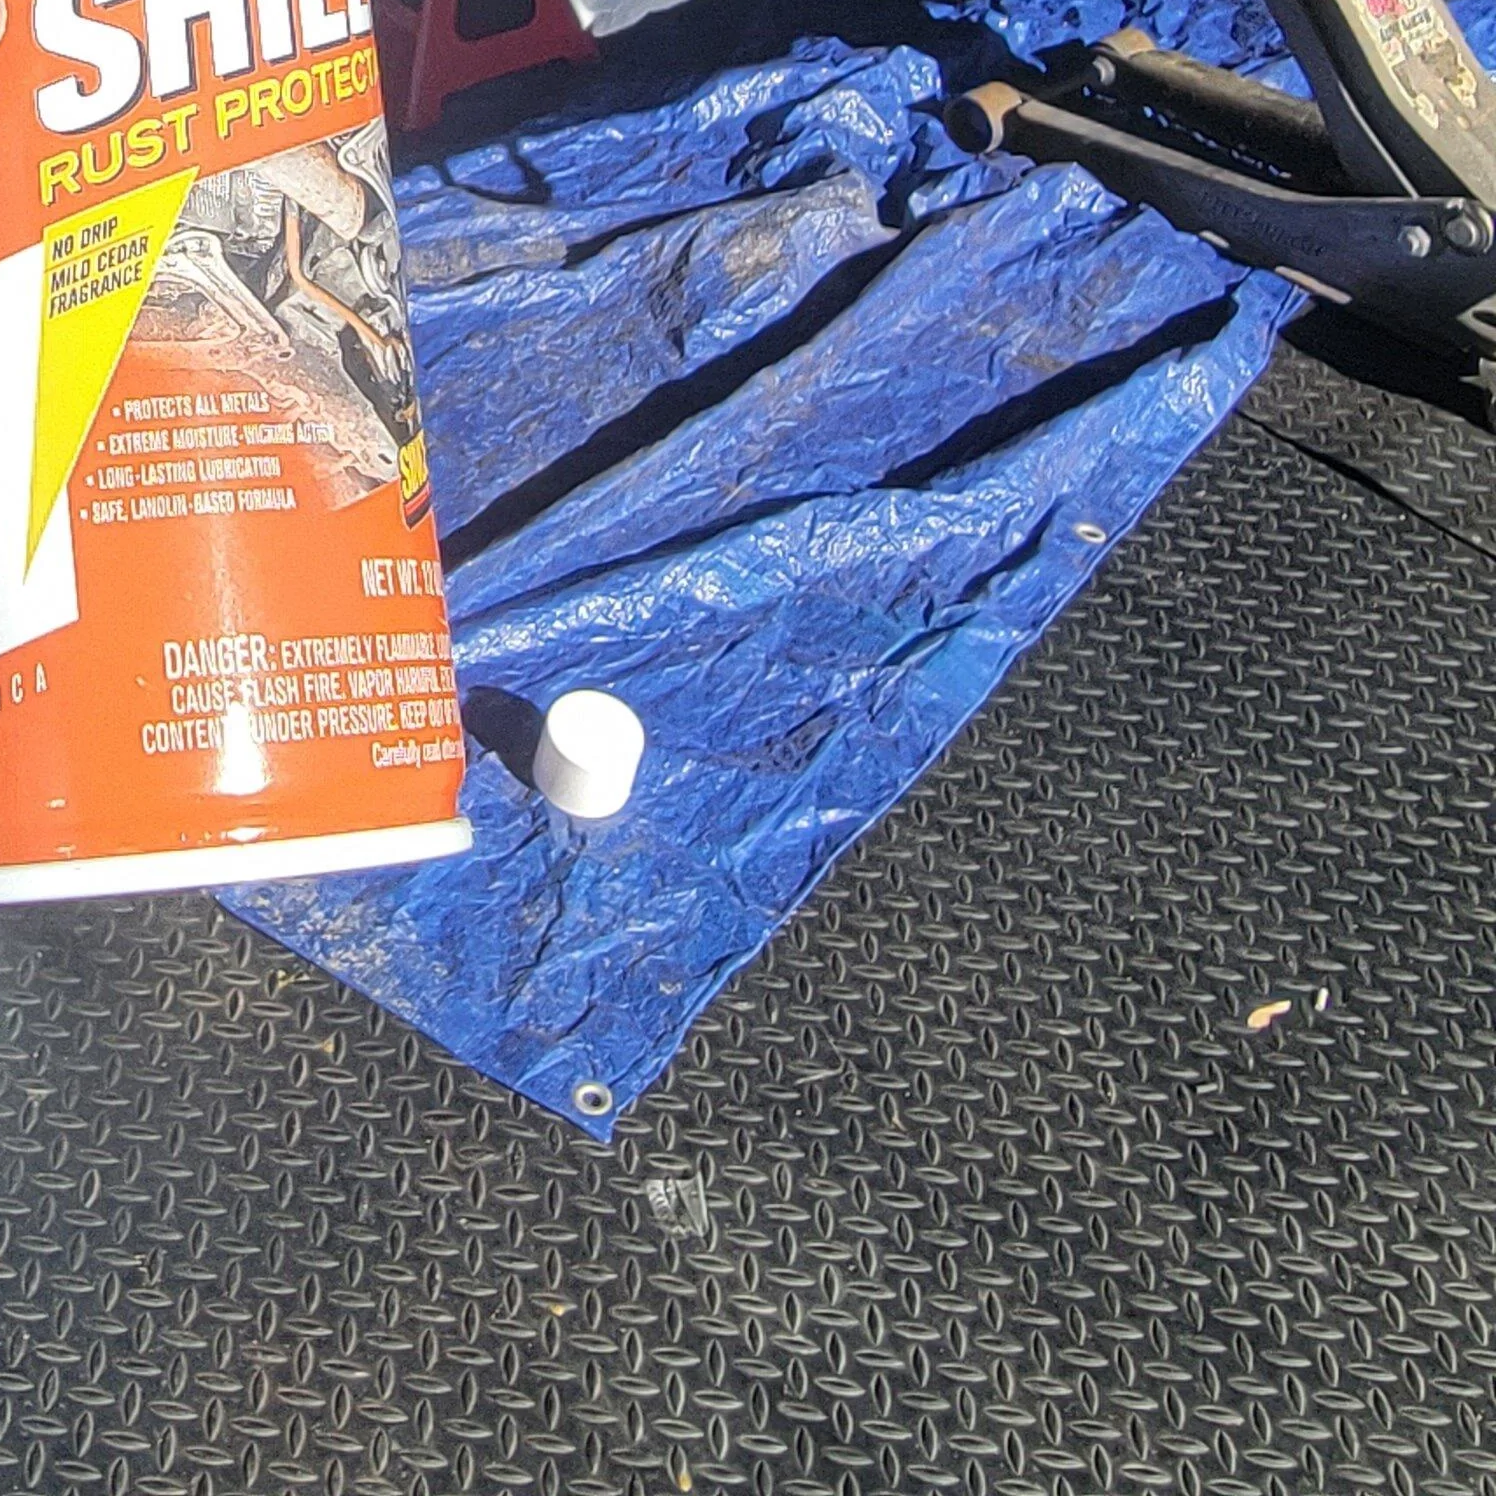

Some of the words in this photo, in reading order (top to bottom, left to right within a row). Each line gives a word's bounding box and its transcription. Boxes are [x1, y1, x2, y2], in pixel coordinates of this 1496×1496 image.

[39, 104, 198, 206] RUST
[52, 238, 74, 261] NO
[80, 216, 119, 250] DRIP
[50, 259, 90, 293] MILD
[98, 235, 149, 272] CEDAR
[49, 261, 143, 319] FRAGRANCE
[124, 395, 193, 422] PROTECTS
[195, 393, 220, 417] ALL
[109, 429, 170, 456] EXTREME
[360, 557, 395, 598] NET
[163, 633, 278, 680] DANGER:
[281, 636, 372, 670] EXTREMELY
[348, 668, 395, 700] VAPOR
[250, 707, 313, 745] UNDER
